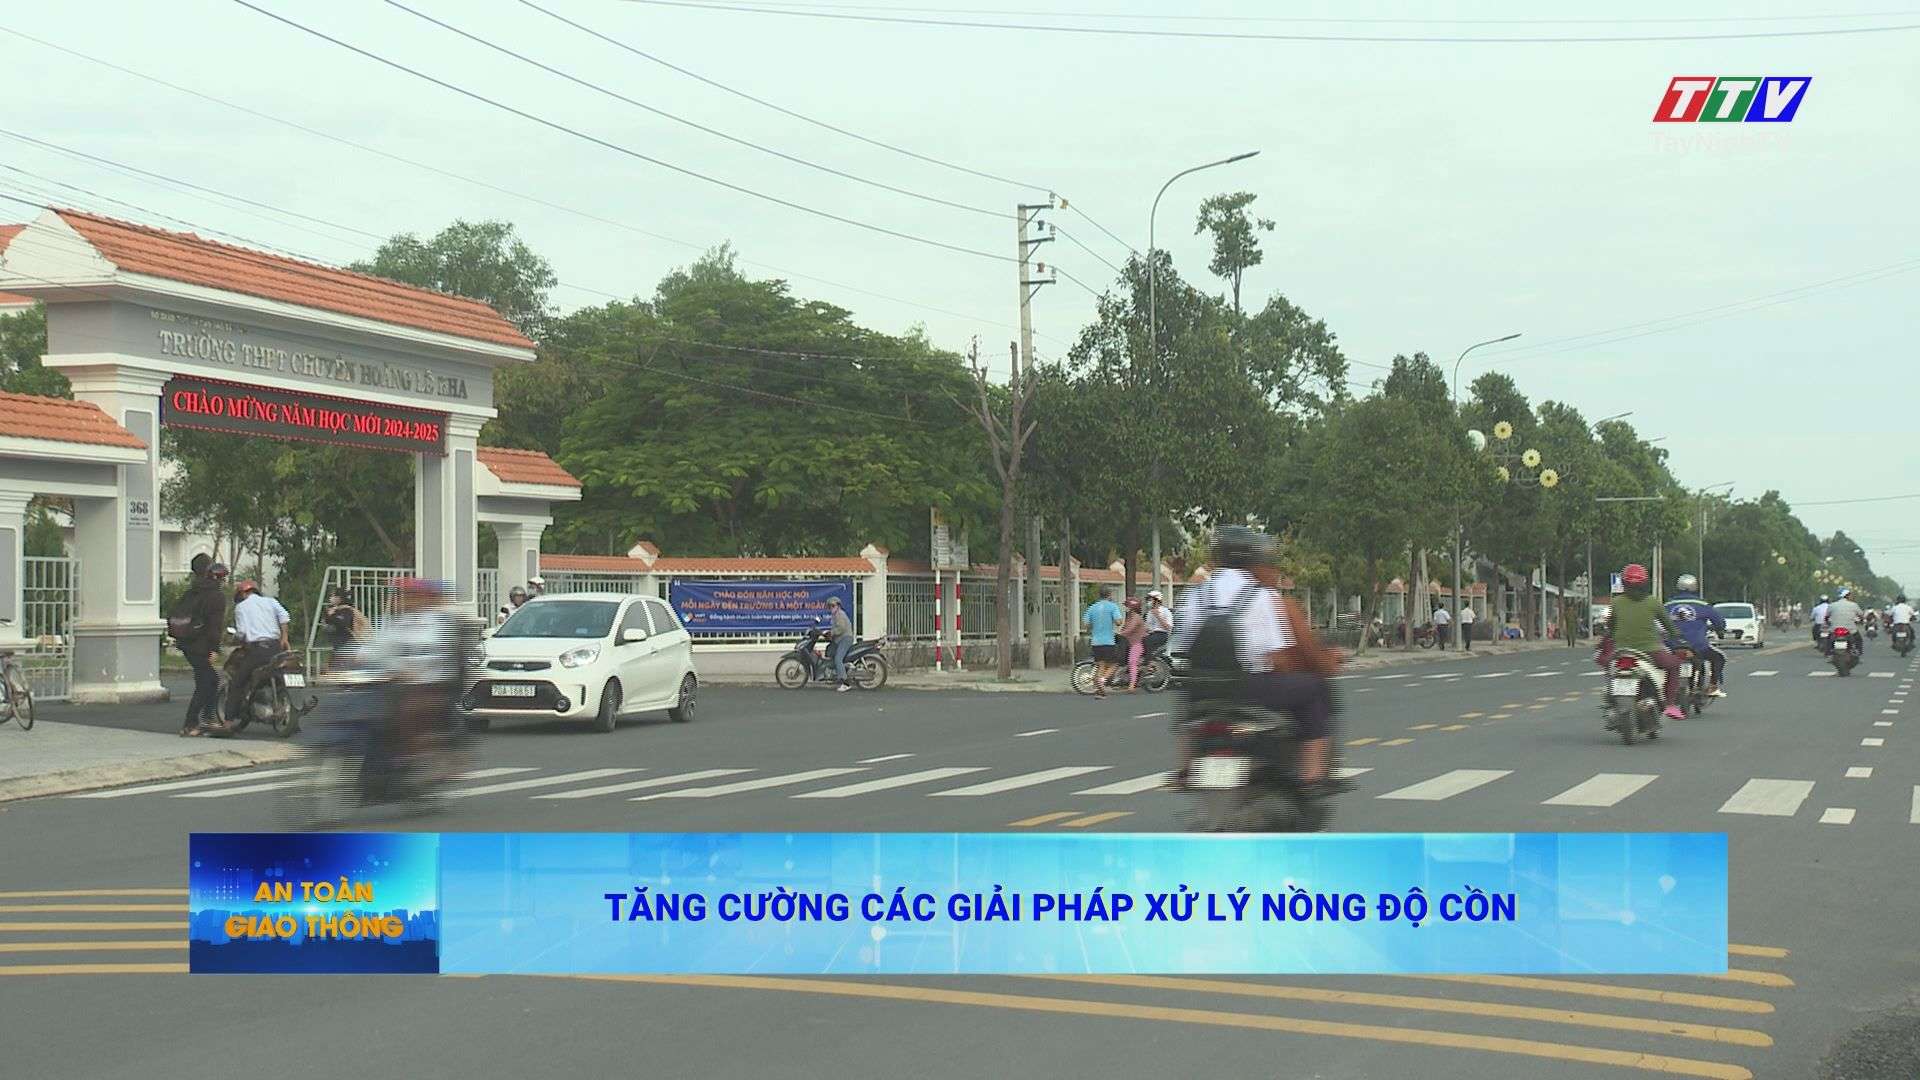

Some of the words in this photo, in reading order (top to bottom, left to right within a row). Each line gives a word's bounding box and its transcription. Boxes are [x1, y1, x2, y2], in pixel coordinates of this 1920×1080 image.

[160, 328, 237, 364] TRƯỜNG
[241, 343, 288, 371] THPT
[290, 351, 355, 383] CHUYÊN
[360, 361, 411, 391] HOÀNG
[415, 368, 435, 395] LÊ
[437, 375, 468, 399] KHA
[172, 386, 224, 416] CHÀO
[226, 394, 278, 422] MỪNG
[280, 401, 316, 427] NĂM
[319, 409, 352, 434] HỌC
[353, 412, 381, 435] MỚI
[383, 418, 439, 441] 2024-2025
[130, 501, 149, 514] 368
